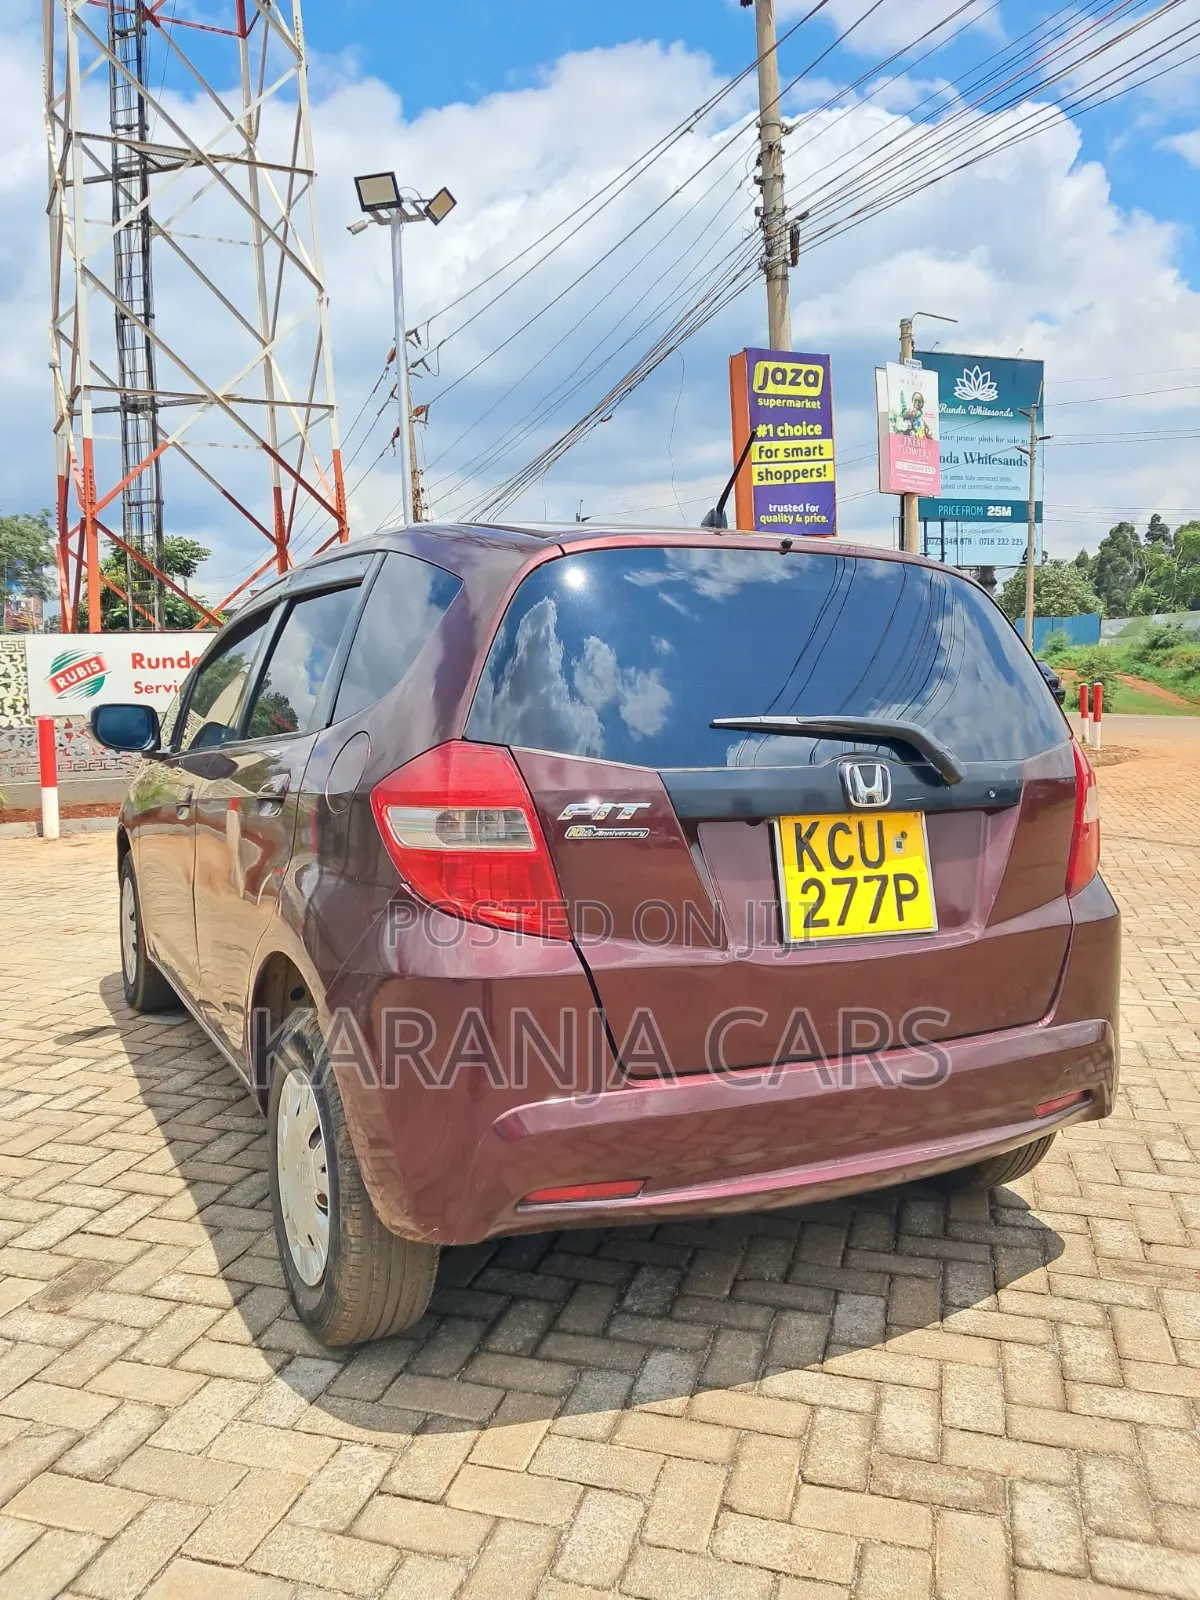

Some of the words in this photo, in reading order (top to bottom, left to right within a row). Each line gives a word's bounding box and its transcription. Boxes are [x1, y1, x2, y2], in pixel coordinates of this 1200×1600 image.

[757, 396, 821, 410] supermarket
[939, 402, 967, 415] Runda
[967, 404, 1014, 418] Whitesands
[756, 423, 774, 438] #1
[776, 421, 823, 437] choice
[904, 437, 926, 449] FRESH
[978, 434, 994, 444] plots
[996, 434, 1005, 443] for
[1006, 435, 1020, 444] sale
[758, 445, 780, 460] for
[783, 443, 824, 458] smart
[898, 445, 932, 460] FLOWERS
[939, 451, 959, 464] nda
[963, 451, 1028, 467] Whitesands
[757, 464, 827, 483] shoppers!
[965, 474, 976, 482] fully
[993, 484, 1021, 492] community
[768, 503, 804, 513] trusted
[805, 502, 820, 513] for
[938, 504, 961, 516] PRICE
[961, 505, 983, 516] FROM
[987, 505, 1012, 517] 25M
[759, 513, 794, 525] quality
[979, 537, 995, 546] 0718
[997, 537, 1009, 546] 222
[1011, 538, 1024, 546] 225
[133, 680, 180, 695] Servi
[557, 802, 652, 821] FIT
[593, 829, 646, 838] Anniversary
[794, 819, 886, 873] KCU
[800, 872, 920, 929] 277P
